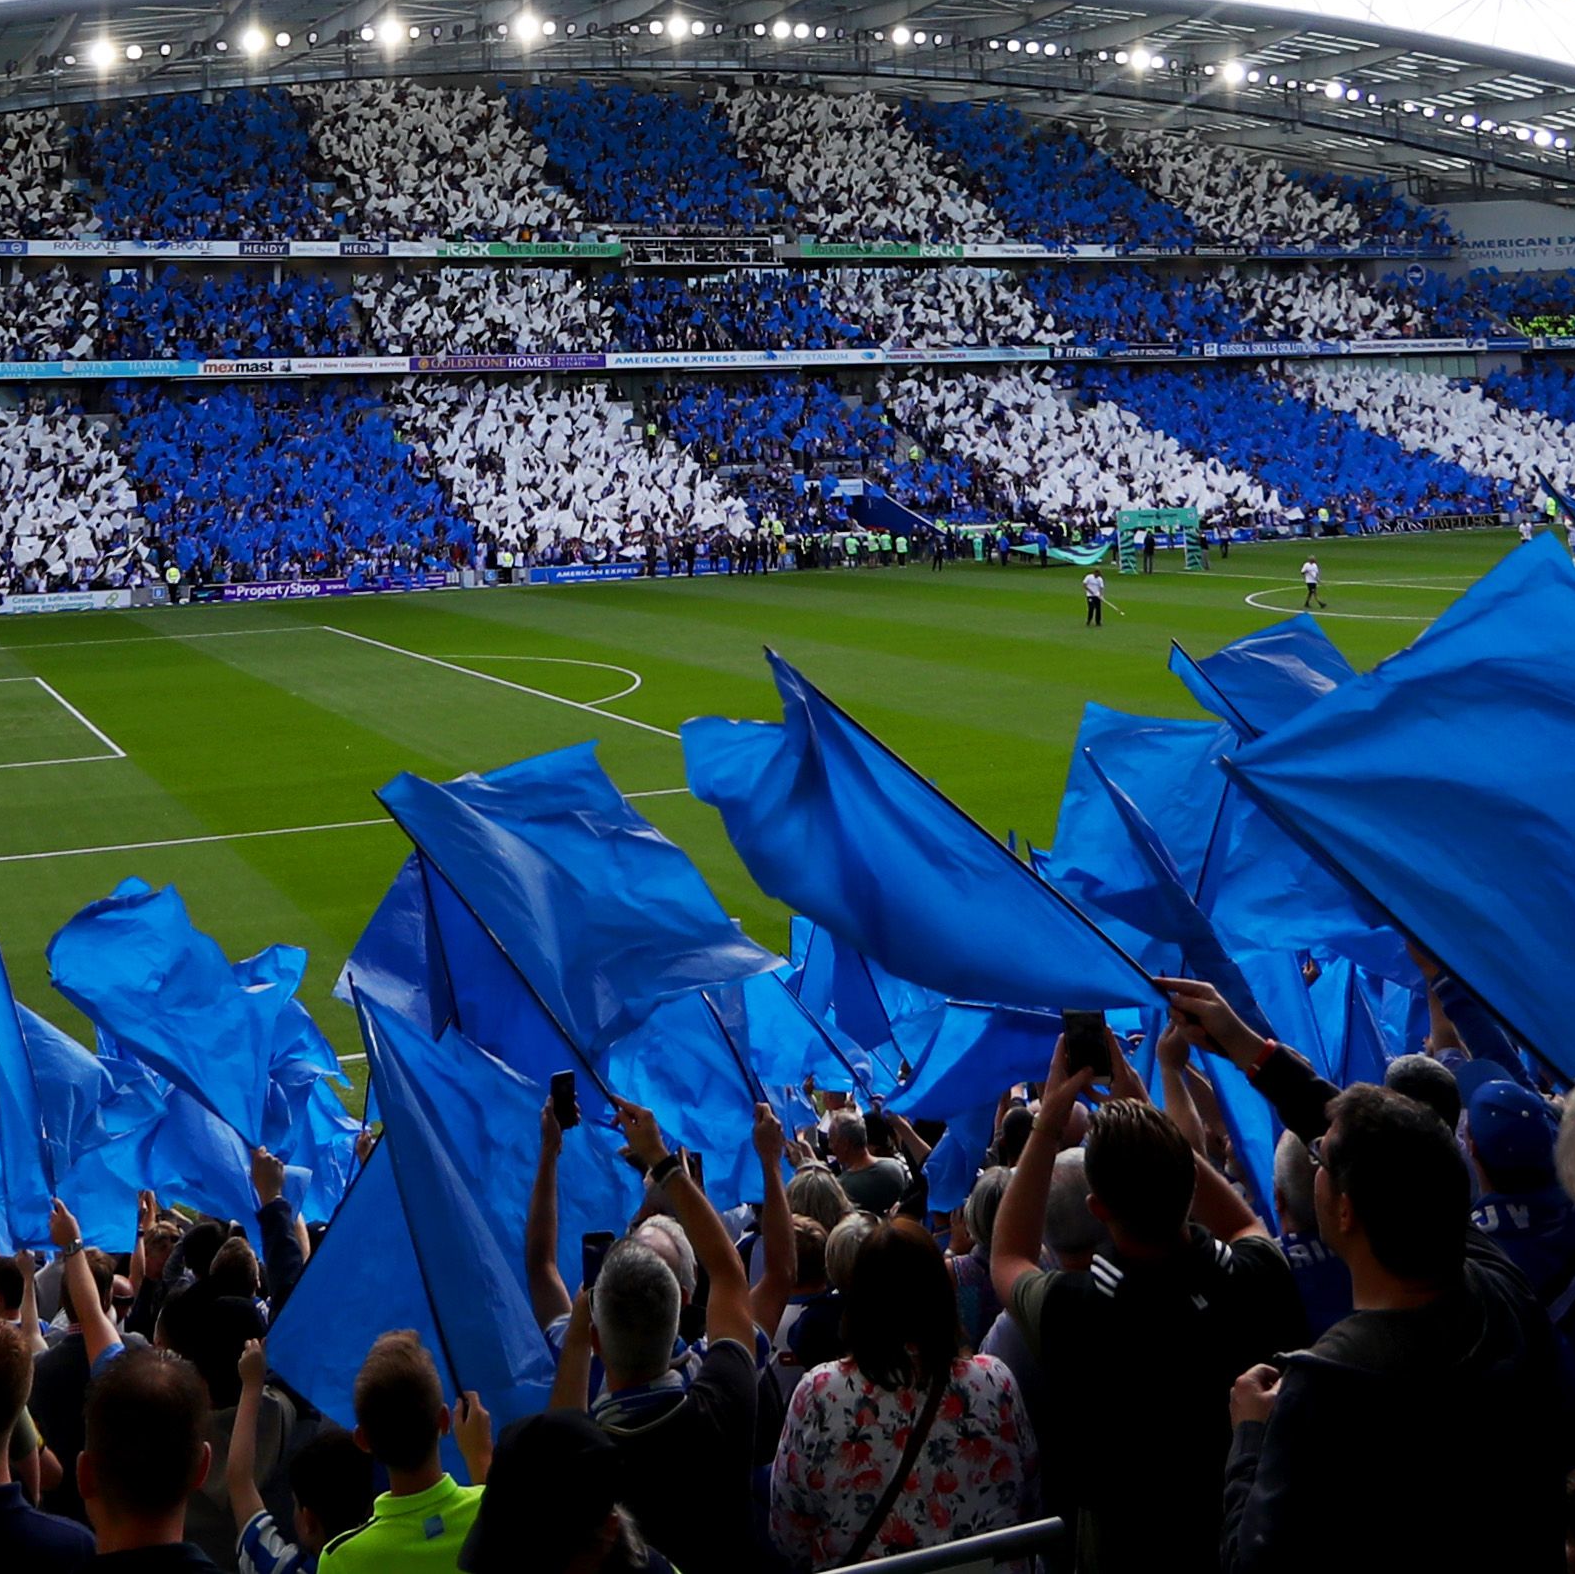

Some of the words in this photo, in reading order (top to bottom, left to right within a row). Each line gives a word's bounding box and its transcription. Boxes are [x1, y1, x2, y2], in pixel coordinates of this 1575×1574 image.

[54, 242, 120, 250] RIVERVALE
[243, 243, 285, 254] HENDY
[1459, 236, 1551, 249] AMERICAN
[1462, 248, 1549, 260] OMMUNITY
[1220, 343, 1250, 355] SUSSEX
[1252, 343, 1276, 354] SKILLS
[1278, 342, 1321, 354] SOLUTIONS
[431, 357, 507, 368] GOLDSTONE
[508, 356, 551, 368] HOMES
[615, 356, 680, 364] AMERICAN
[683, 355, 737, 363] EXPRESS
[740, 353, 801, 363] COMNITY
[806, 352, 849, 361] STADIUM
[73, 361, 113, 371] ARVEY'S
[203, 361, 274, 373] mexmast
[1428, 515, 1495, 530] JEWELLERS
[556, 569, 603, 578] AMERICAN
